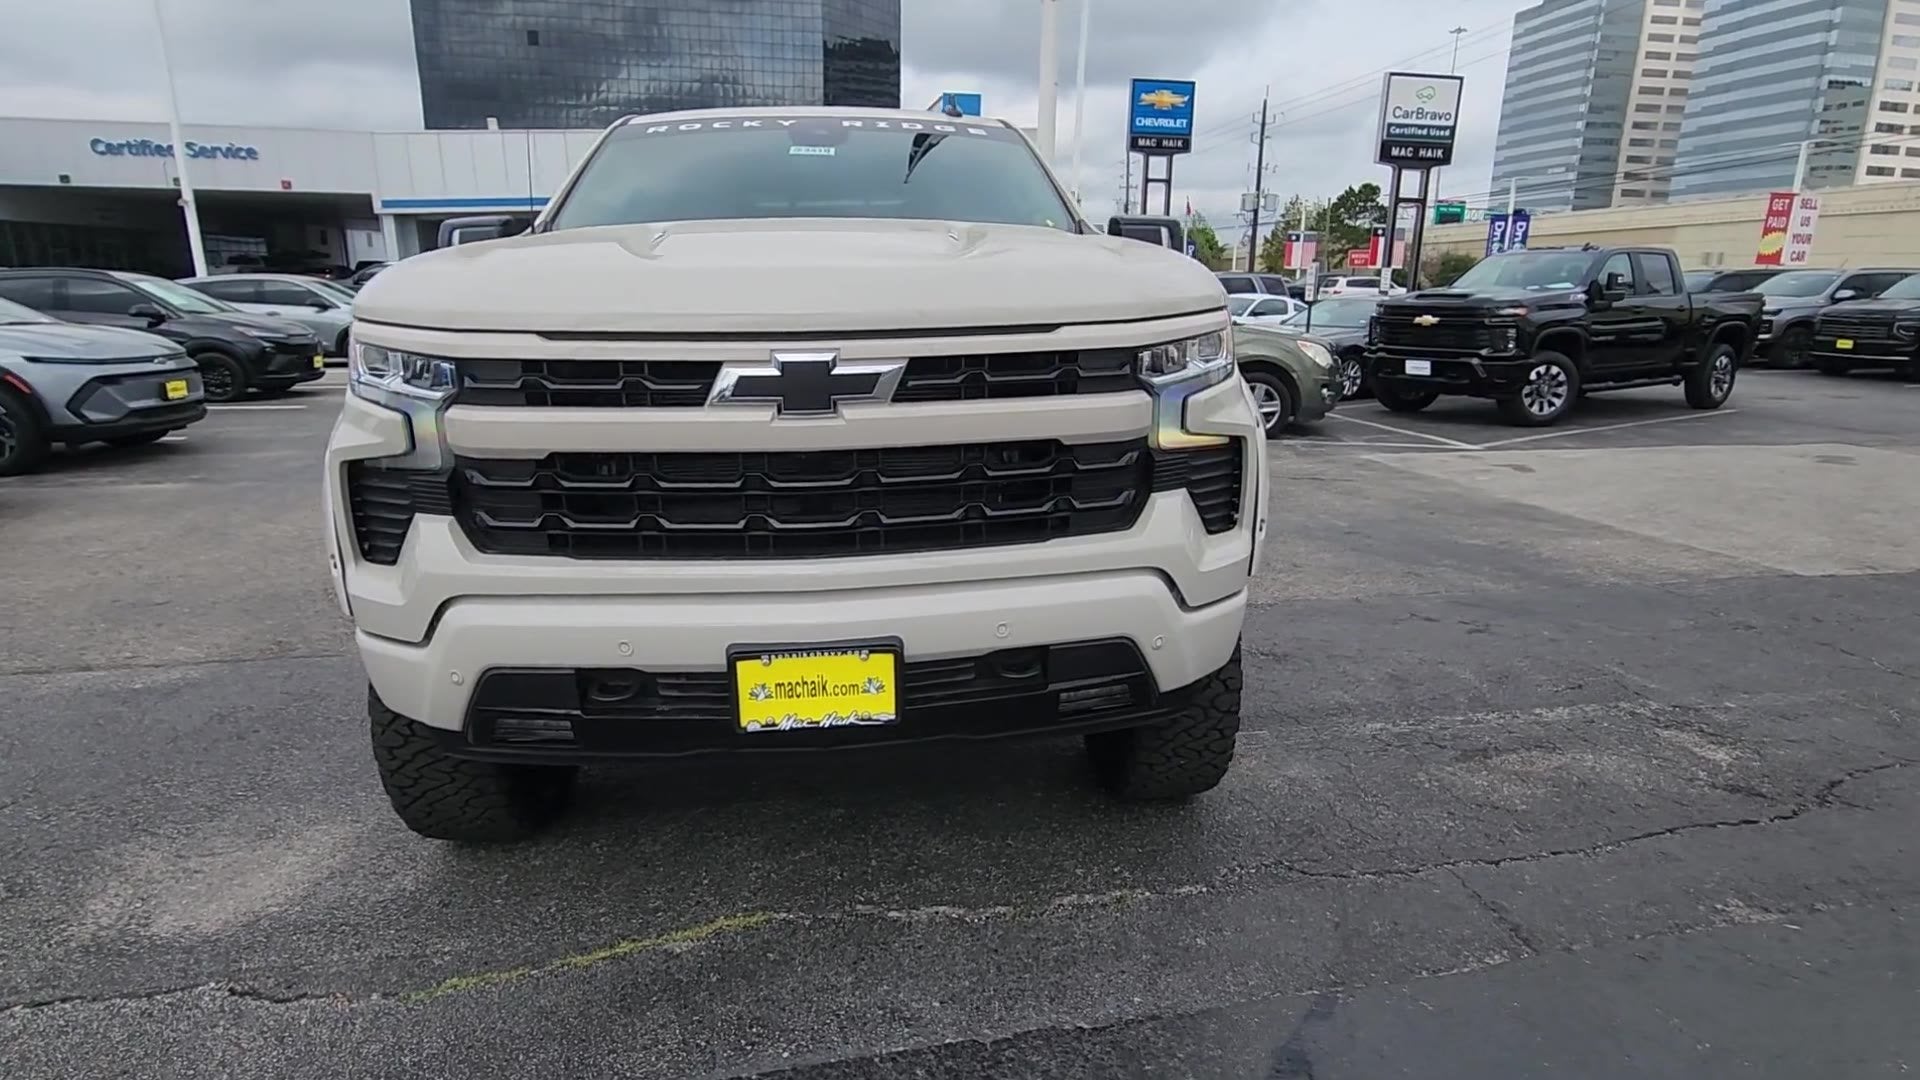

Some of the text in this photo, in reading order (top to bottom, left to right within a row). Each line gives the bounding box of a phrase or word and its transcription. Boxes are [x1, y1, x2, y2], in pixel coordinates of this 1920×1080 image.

[1392, 105, 1452, 121] CarBravo
[645, 119, 988, 136] ROCKY RIDGE
[1135, 117, 1188, 128] CHEVROLET
[1390, 126, 1450, 136] Certified Used
[1138, 138, 1184, 148] MAC HAIK
[184, 141, 259, 161] Service
[1391, 146, 1444, 158] MAC HAIK
[1772, 199, 1790, 211] GET
[1800, 198, 1818, 210] SELL
[1767, 216, 1787, 228] PAID
[1800, 216, 1811, 227] US
[1792, 233, 1813, 245] YOUR
[1790, 250, 1806, 262] CAR
[775, 675, 860, 700] machaik.com
[778, 713, 816, 731] Mac
